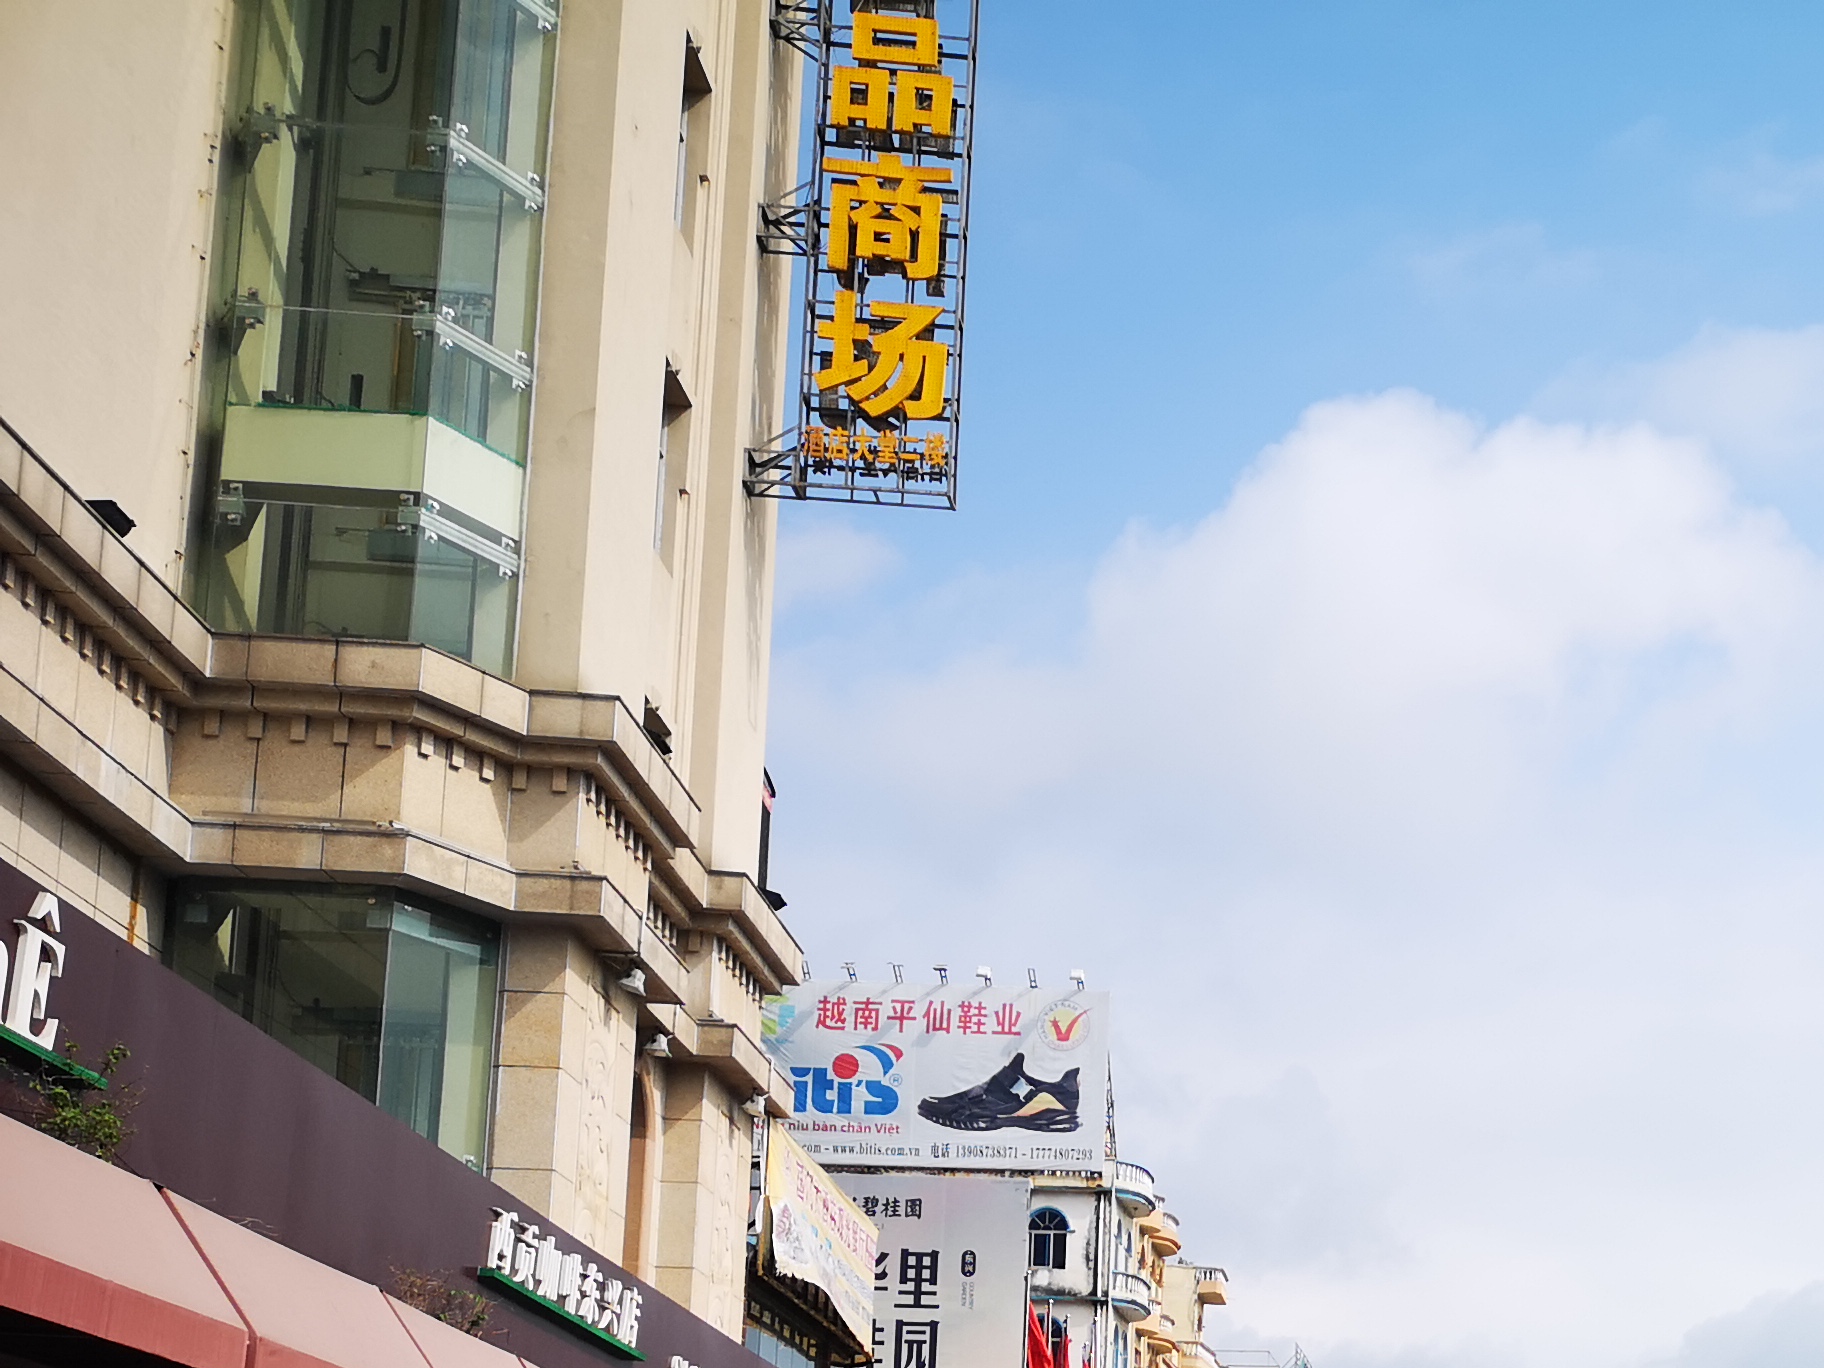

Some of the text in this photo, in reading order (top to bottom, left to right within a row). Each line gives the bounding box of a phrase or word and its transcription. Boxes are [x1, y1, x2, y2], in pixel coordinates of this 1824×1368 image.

[813, 11, 955, 421] 品商场
[803, 424, 947, 467] 酒店大堂二楼
[815, 995, 1022, 1037] 越南平仙鞋业
[789, 1053, 900, 1116] iti's
[930, 1143, 950, 1159] 电话
